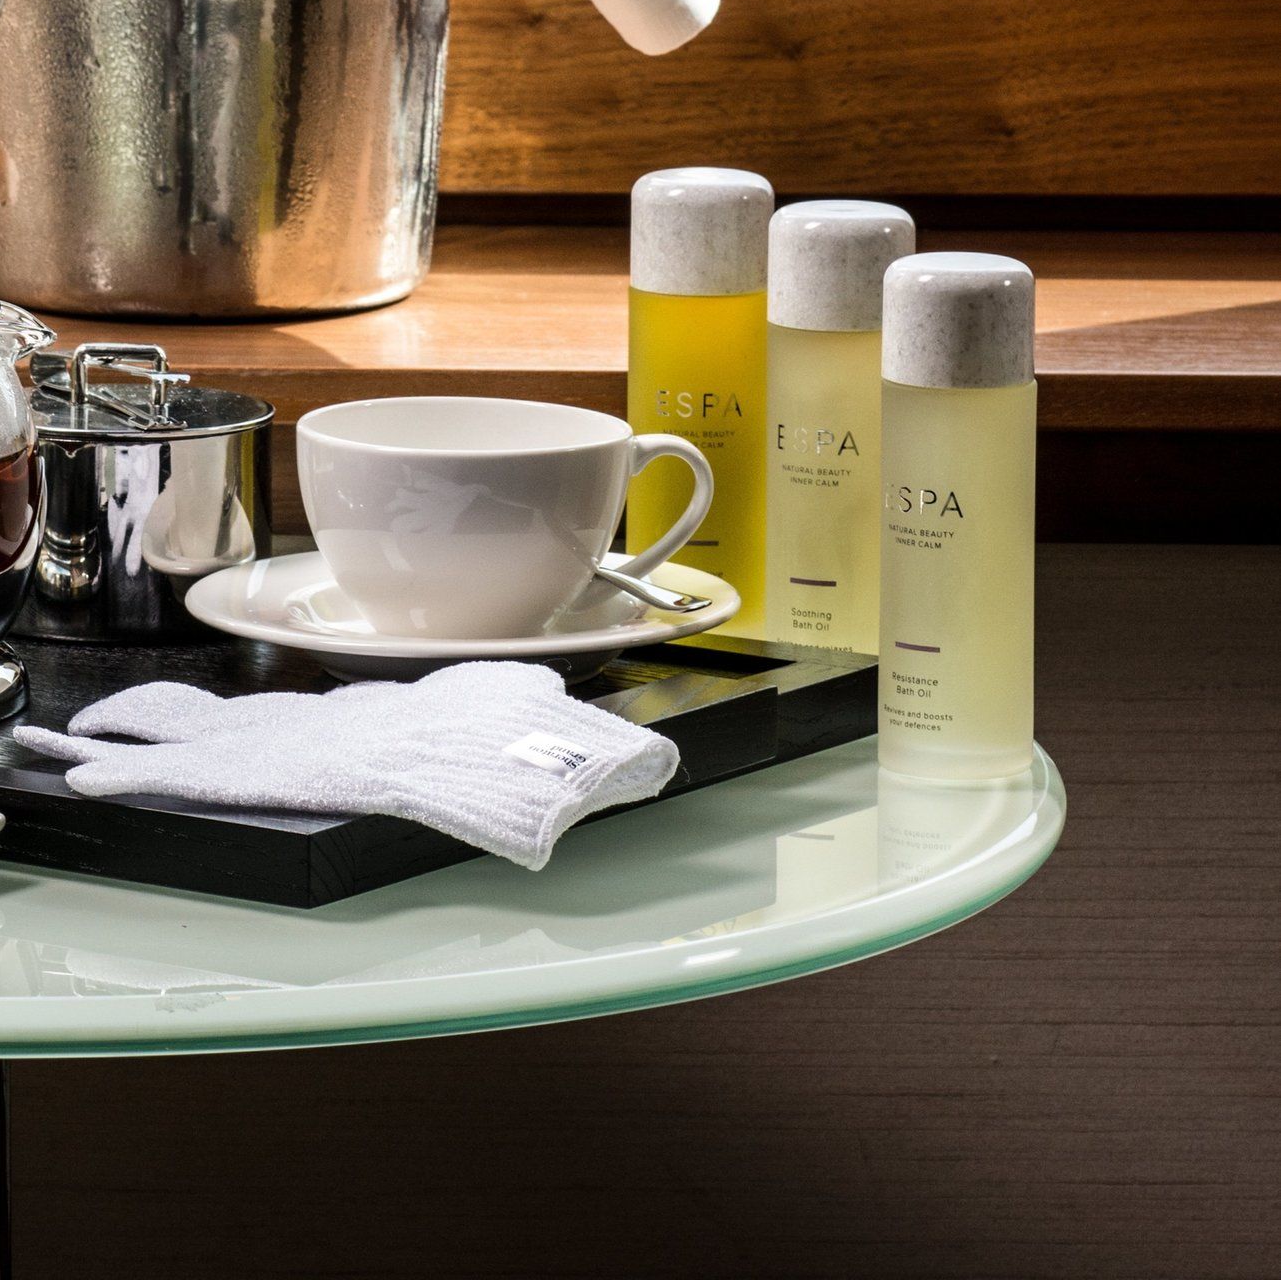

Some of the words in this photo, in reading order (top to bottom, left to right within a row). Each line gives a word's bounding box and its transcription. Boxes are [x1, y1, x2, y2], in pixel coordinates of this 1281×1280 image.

[657, 390, 742, 418] ESPA
[702, 430, 736, 439] BEAUTY
[777, 423, 860, 457] ESPA
[701, 441, 725, 449] CALM
[782, 463, 815, 476] NATURAL
[817, 467, 852, 477] BEAUTY
[790, 475, 813, 486] INNER
[815, 478, 840, 488] CALM
[884, 482, 964, 518] ESPA
[888, 523, 918, 537] NATURAL
[919, 528, 955, 539] BEAUTY
[895, 536, 916, 547] INNER
[918, 540, 942, 550] CALM
[791, 607, 833, 621] Soothing
[792, 619, 813, 631] Bath
[815, 622, 830, 632] Oil
[891, 671, 939, 687] Resistance
[896, 684, 916, 697] Bath
[917, 688, 932, 699] Oil
[883, 703, 906, 717] Revives
[907, 711, 922, 720] and
[923, 712, 954, 722] boosts
[889, 718, 903, 728] your
[904, 721, 942, 732] defences
[529, 744, 578, 771] Sheraton
[549, 744, 587, 764] Grand
